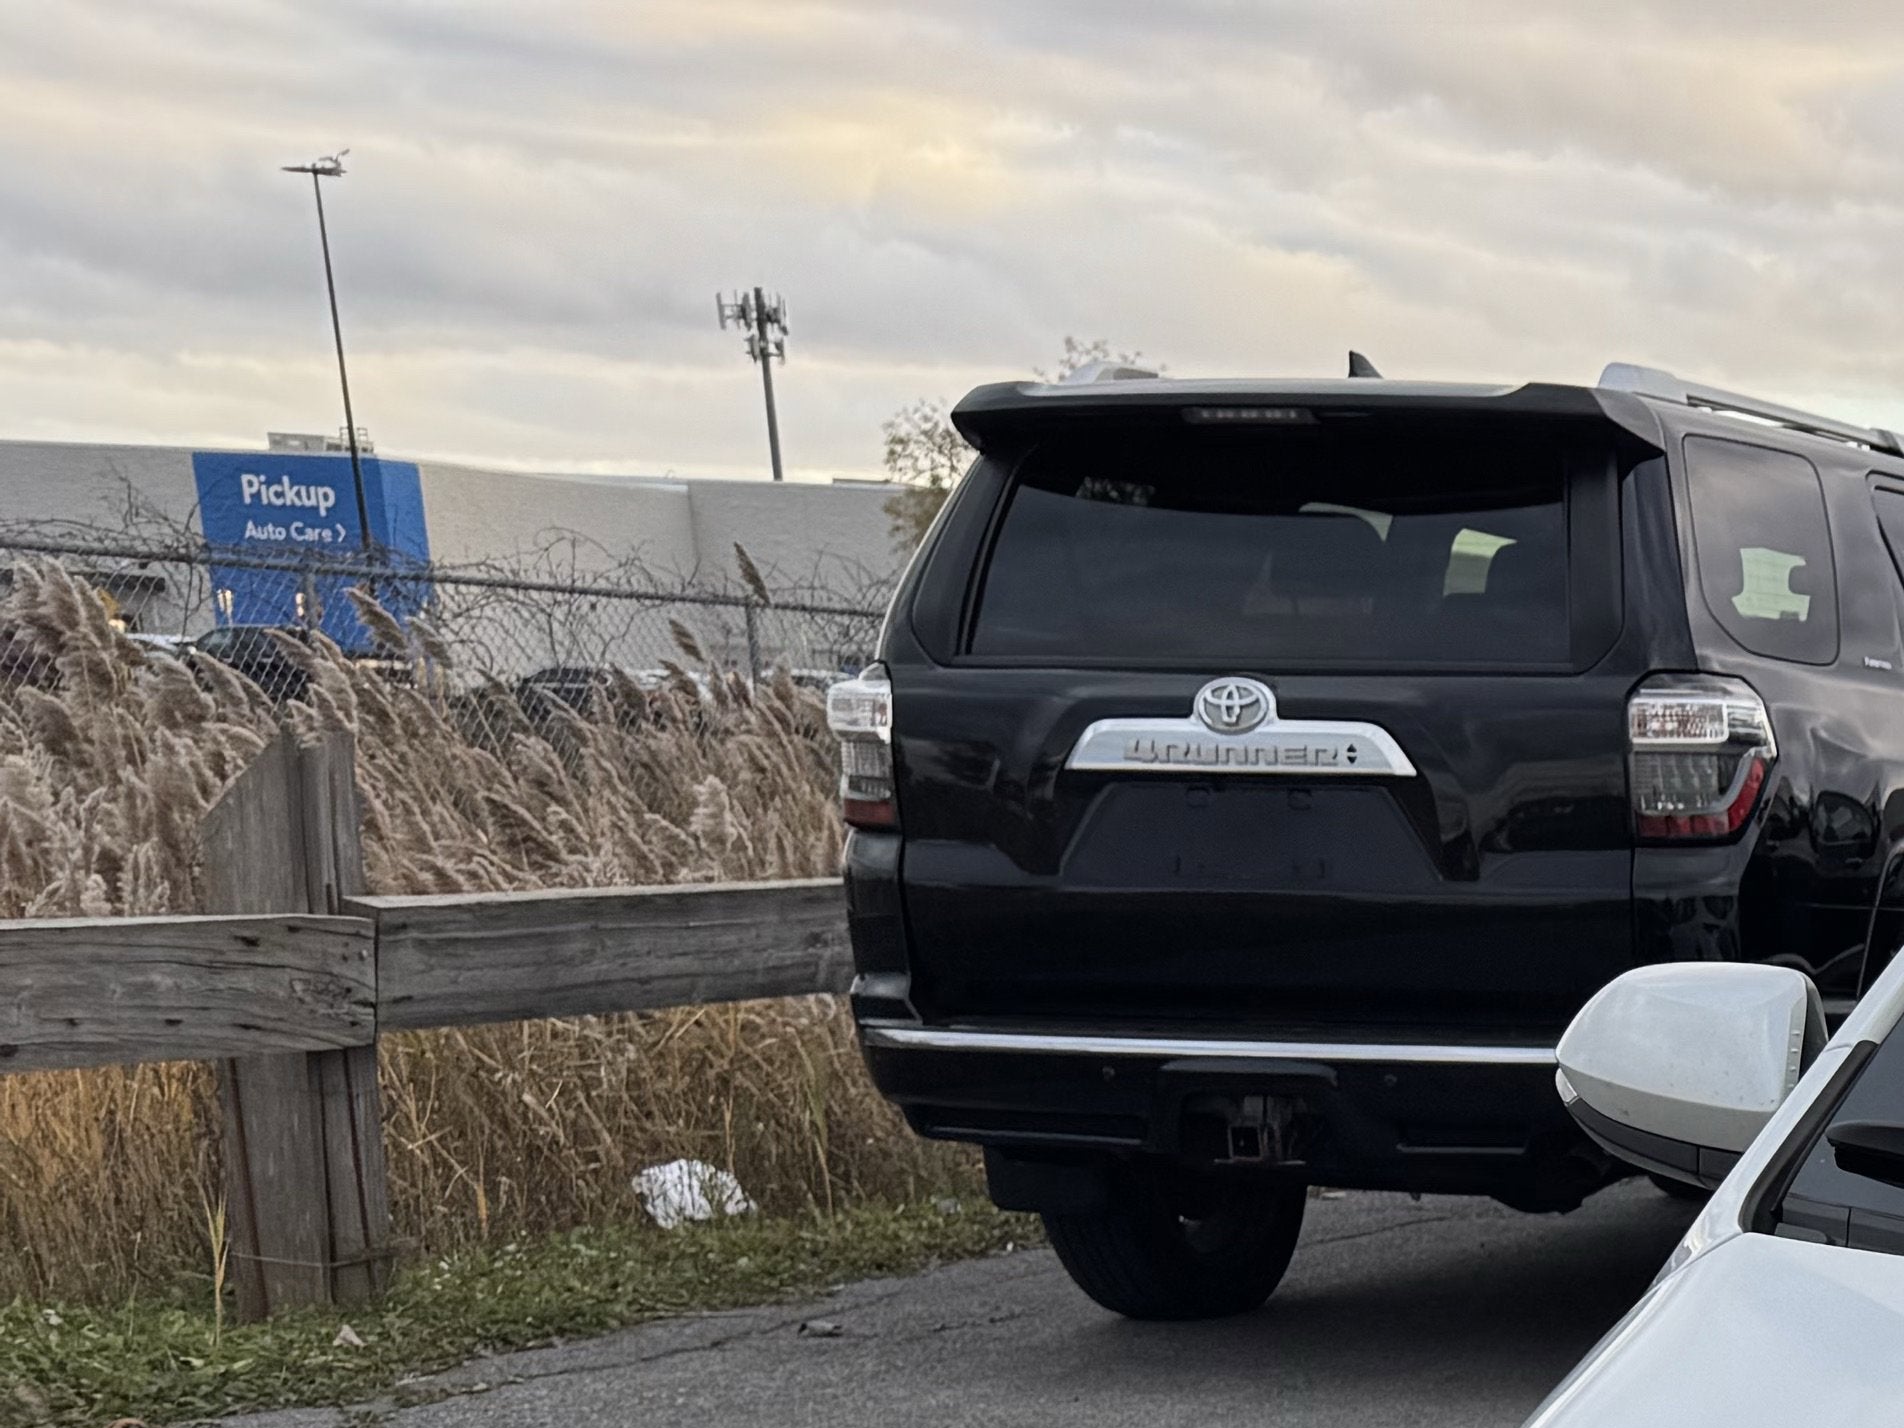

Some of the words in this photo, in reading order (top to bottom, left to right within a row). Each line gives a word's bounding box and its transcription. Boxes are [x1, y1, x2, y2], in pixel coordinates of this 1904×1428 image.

[241, 474, 336, 517] Pickup
[245, 520, 287, 541] Auto
[290, 521, 333, 542] Care
[1123, 739, 1341, 767] 4RUNNER
